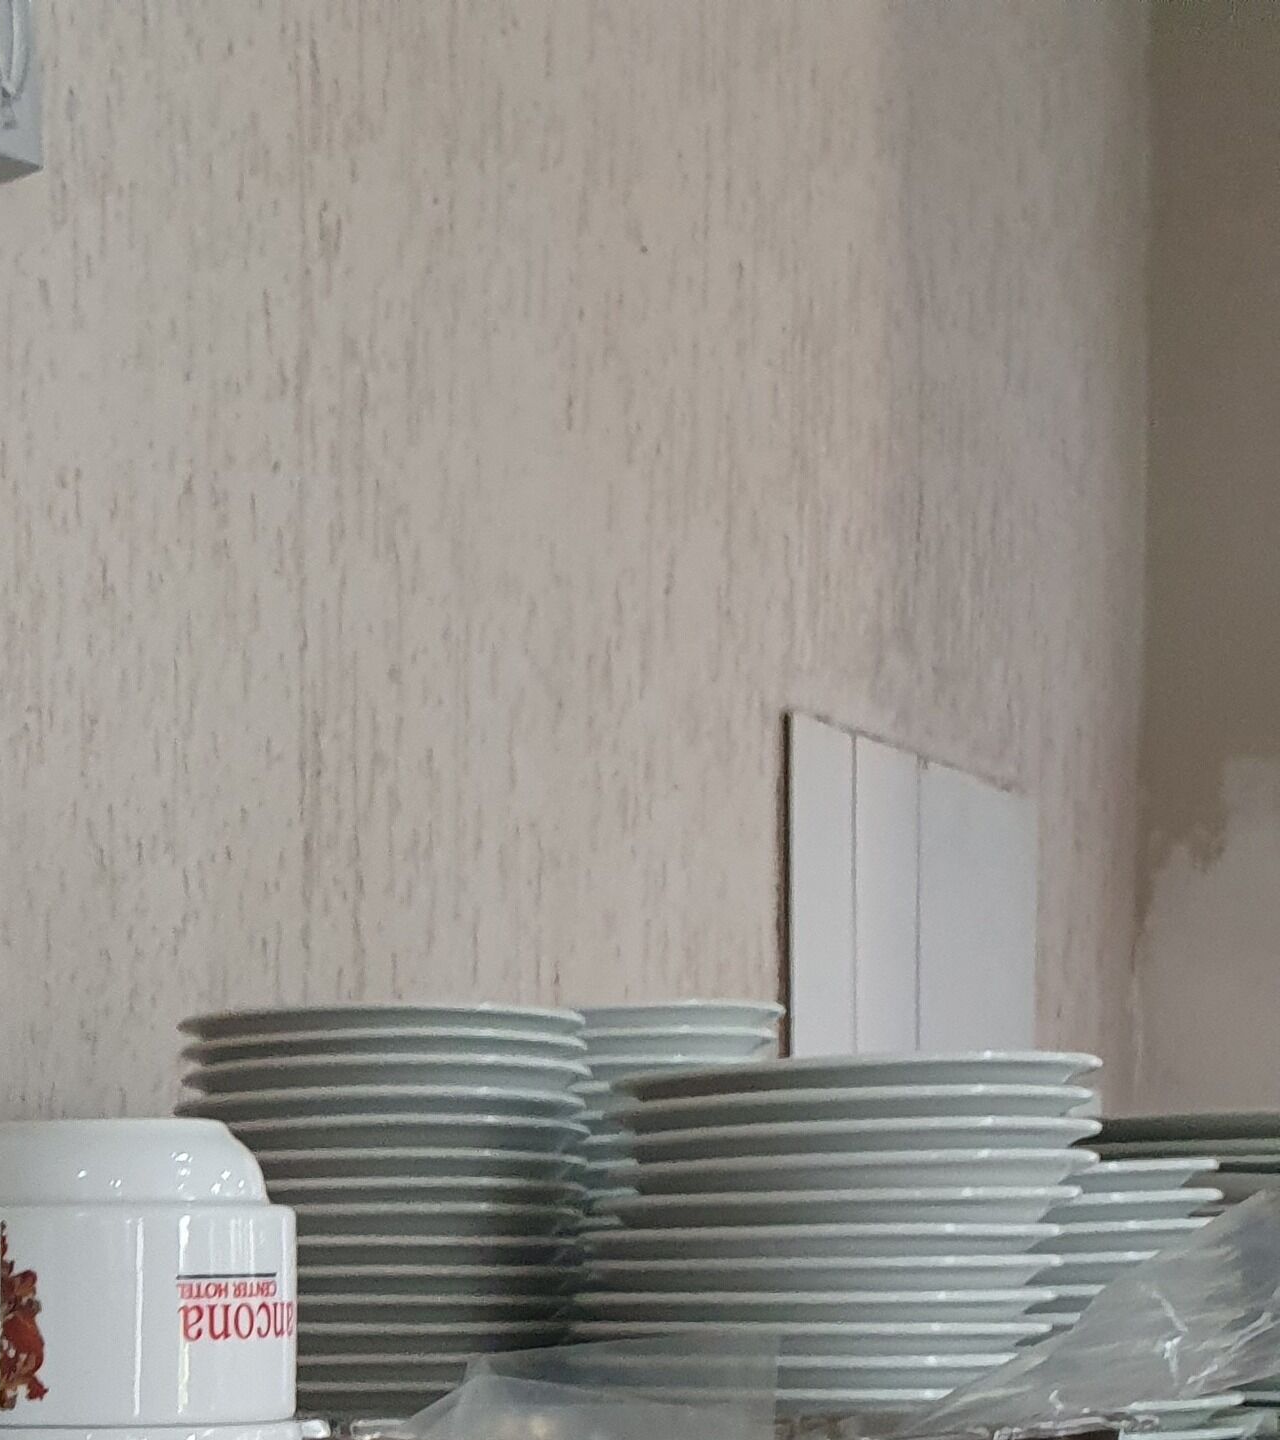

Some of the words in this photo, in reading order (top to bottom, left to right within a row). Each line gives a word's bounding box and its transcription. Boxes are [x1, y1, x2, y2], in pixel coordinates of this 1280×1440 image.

[176, 1282, 228, 1300] HOTEL
[233, 1280, 277, 1298] CENTER
[177, 1301, 295, 1342] ancona
